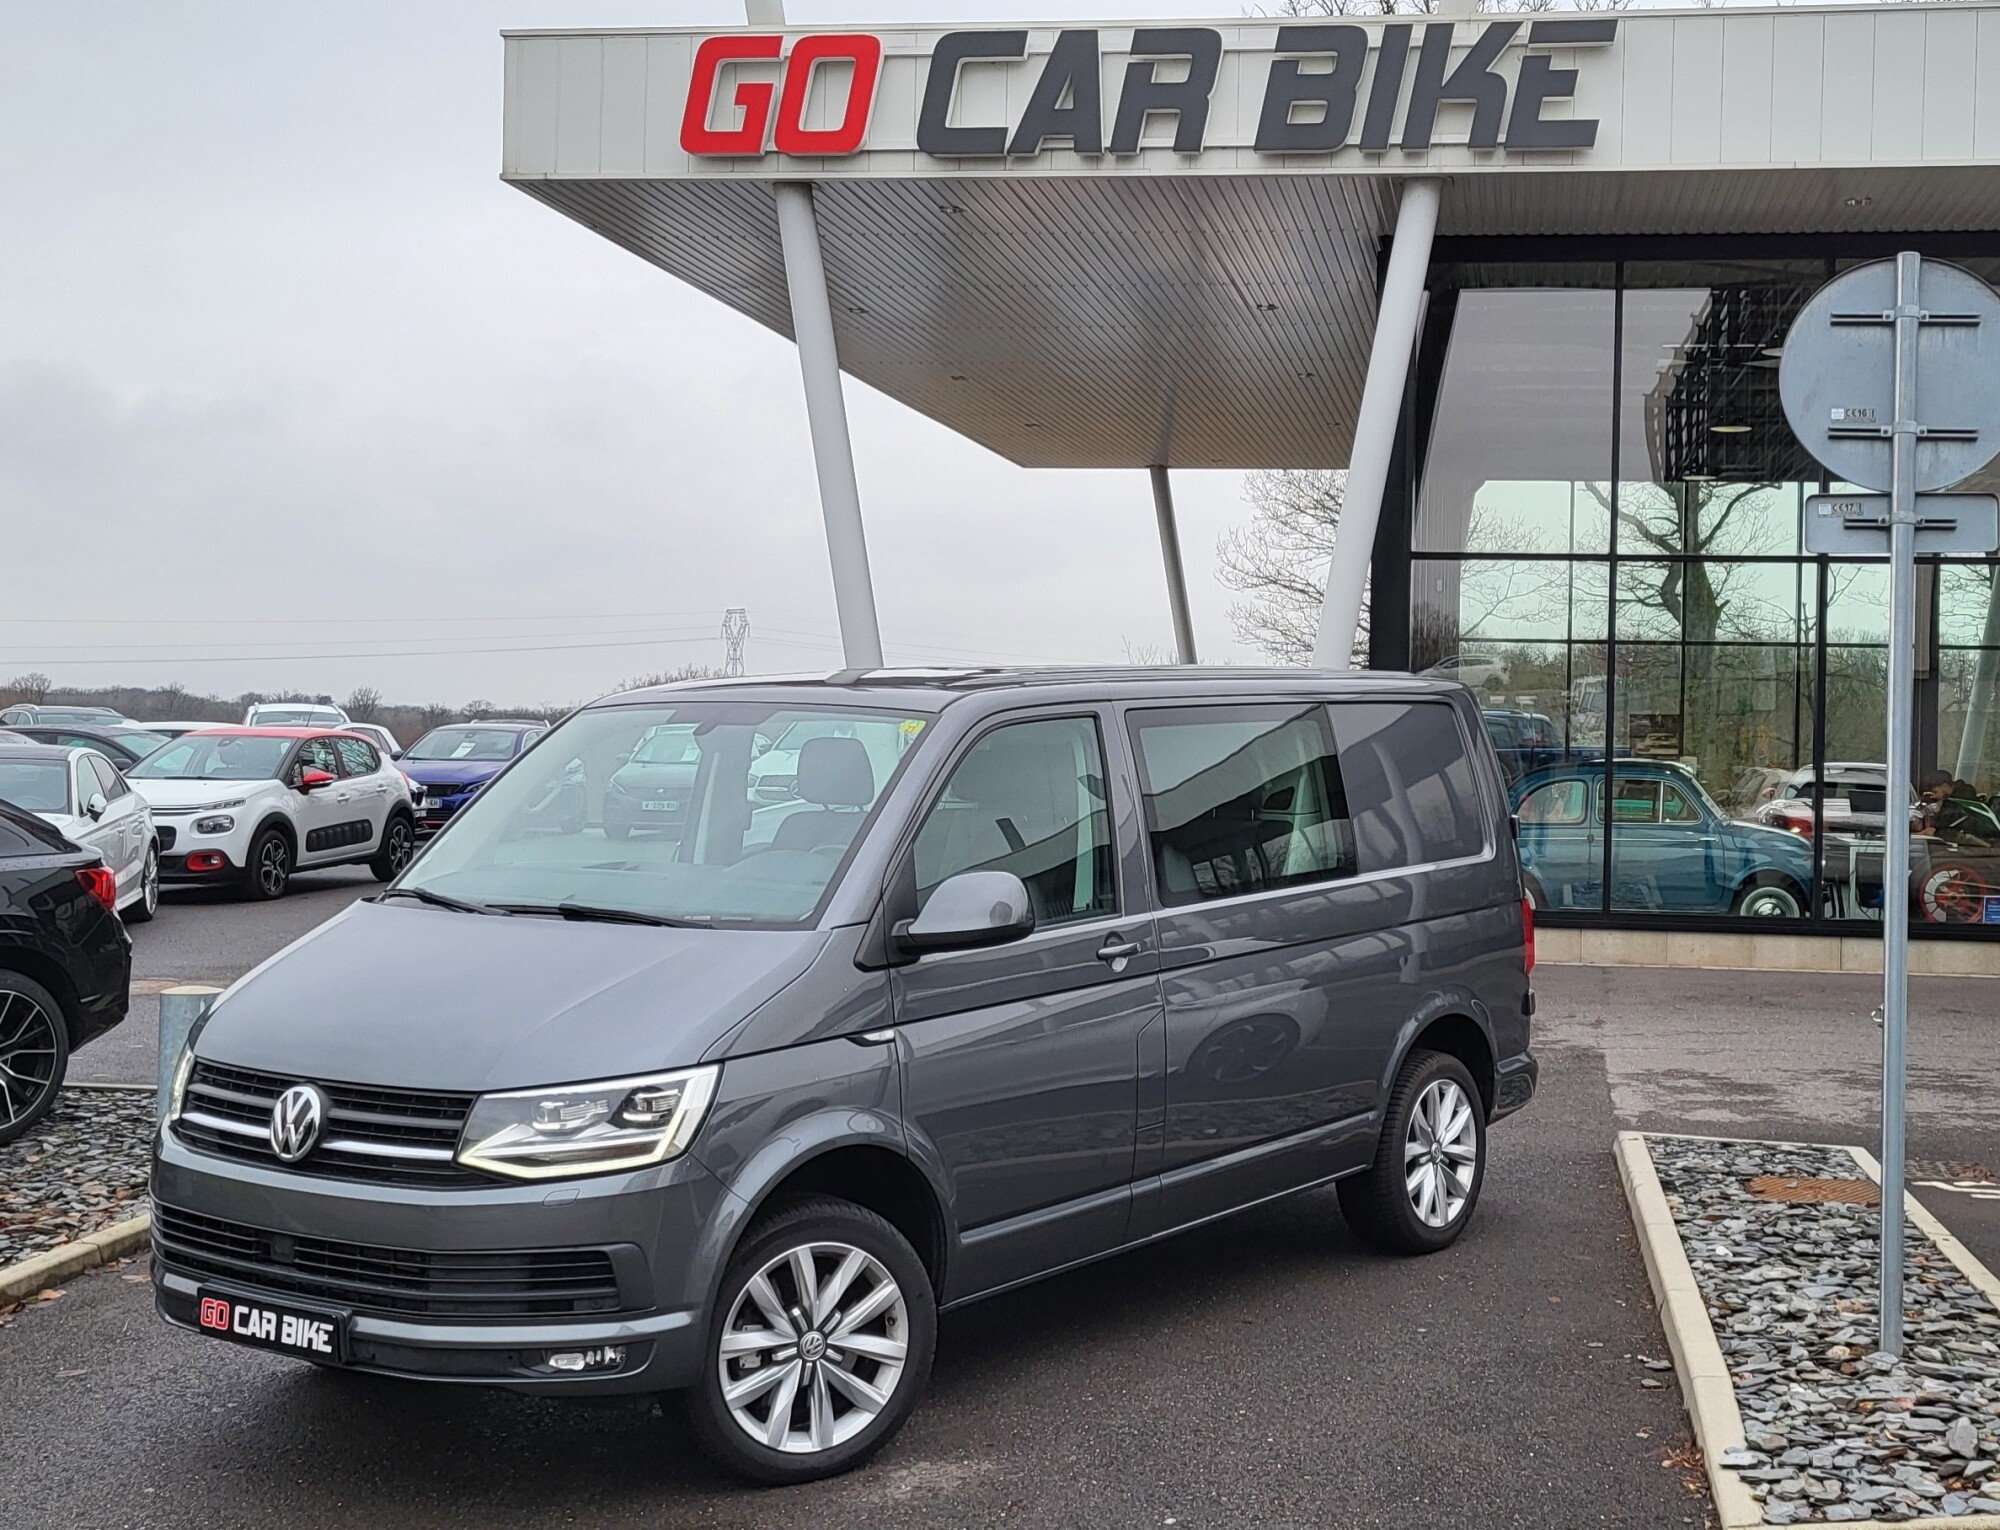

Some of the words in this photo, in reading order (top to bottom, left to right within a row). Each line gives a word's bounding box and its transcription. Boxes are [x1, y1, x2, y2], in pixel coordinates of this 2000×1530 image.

[679, 34, 882, 157] GO
[916, 27, 1223, 157] CAR
[1253, 18, 1619, 153] BIKE
[200, 1297, 230, 1331] GO
[233, 1305, 277, 1342] CAR
[280, 1315, 334, 1354] BIKE
